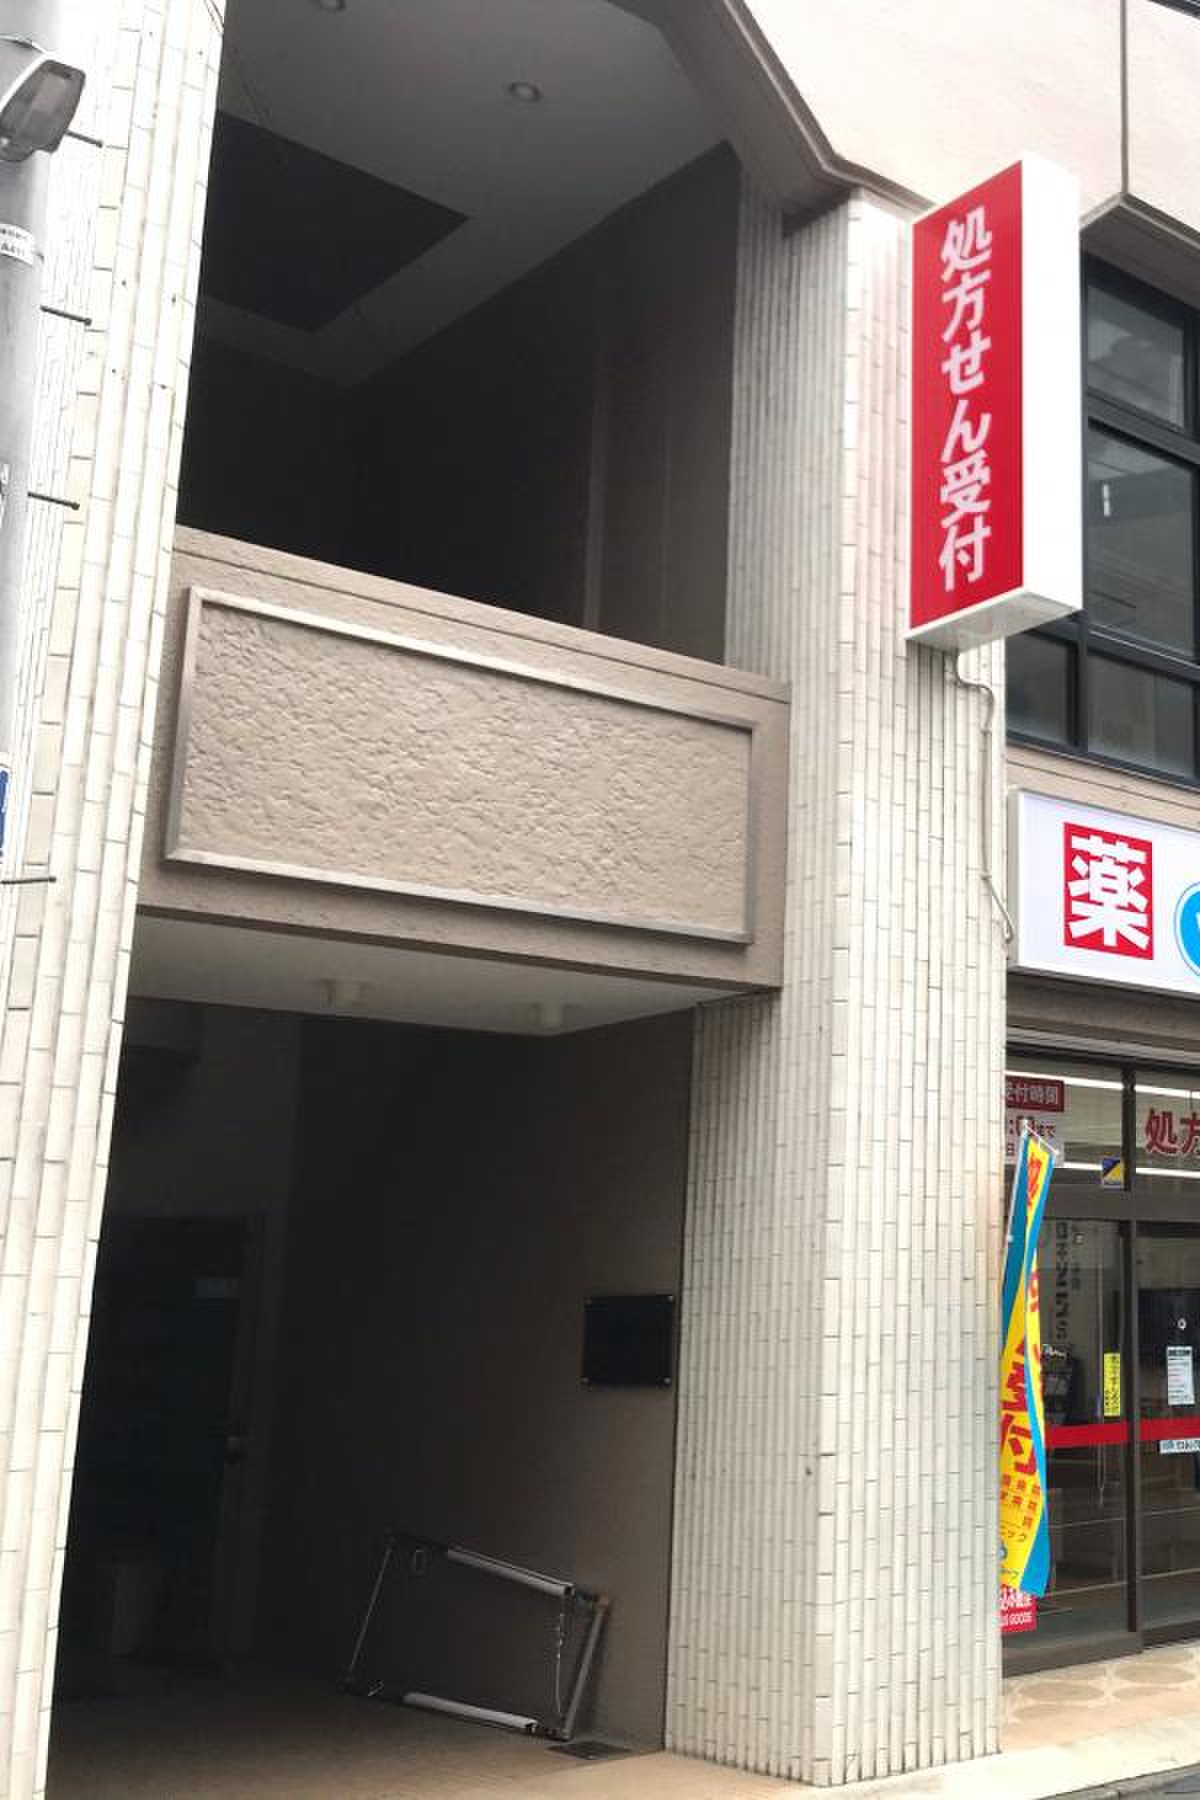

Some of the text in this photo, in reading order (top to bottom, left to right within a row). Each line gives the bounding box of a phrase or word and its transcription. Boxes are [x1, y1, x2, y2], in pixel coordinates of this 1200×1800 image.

[938, 205, 992, 592] 処方せん受付
[1067, 829, 1149, 950] 薬
